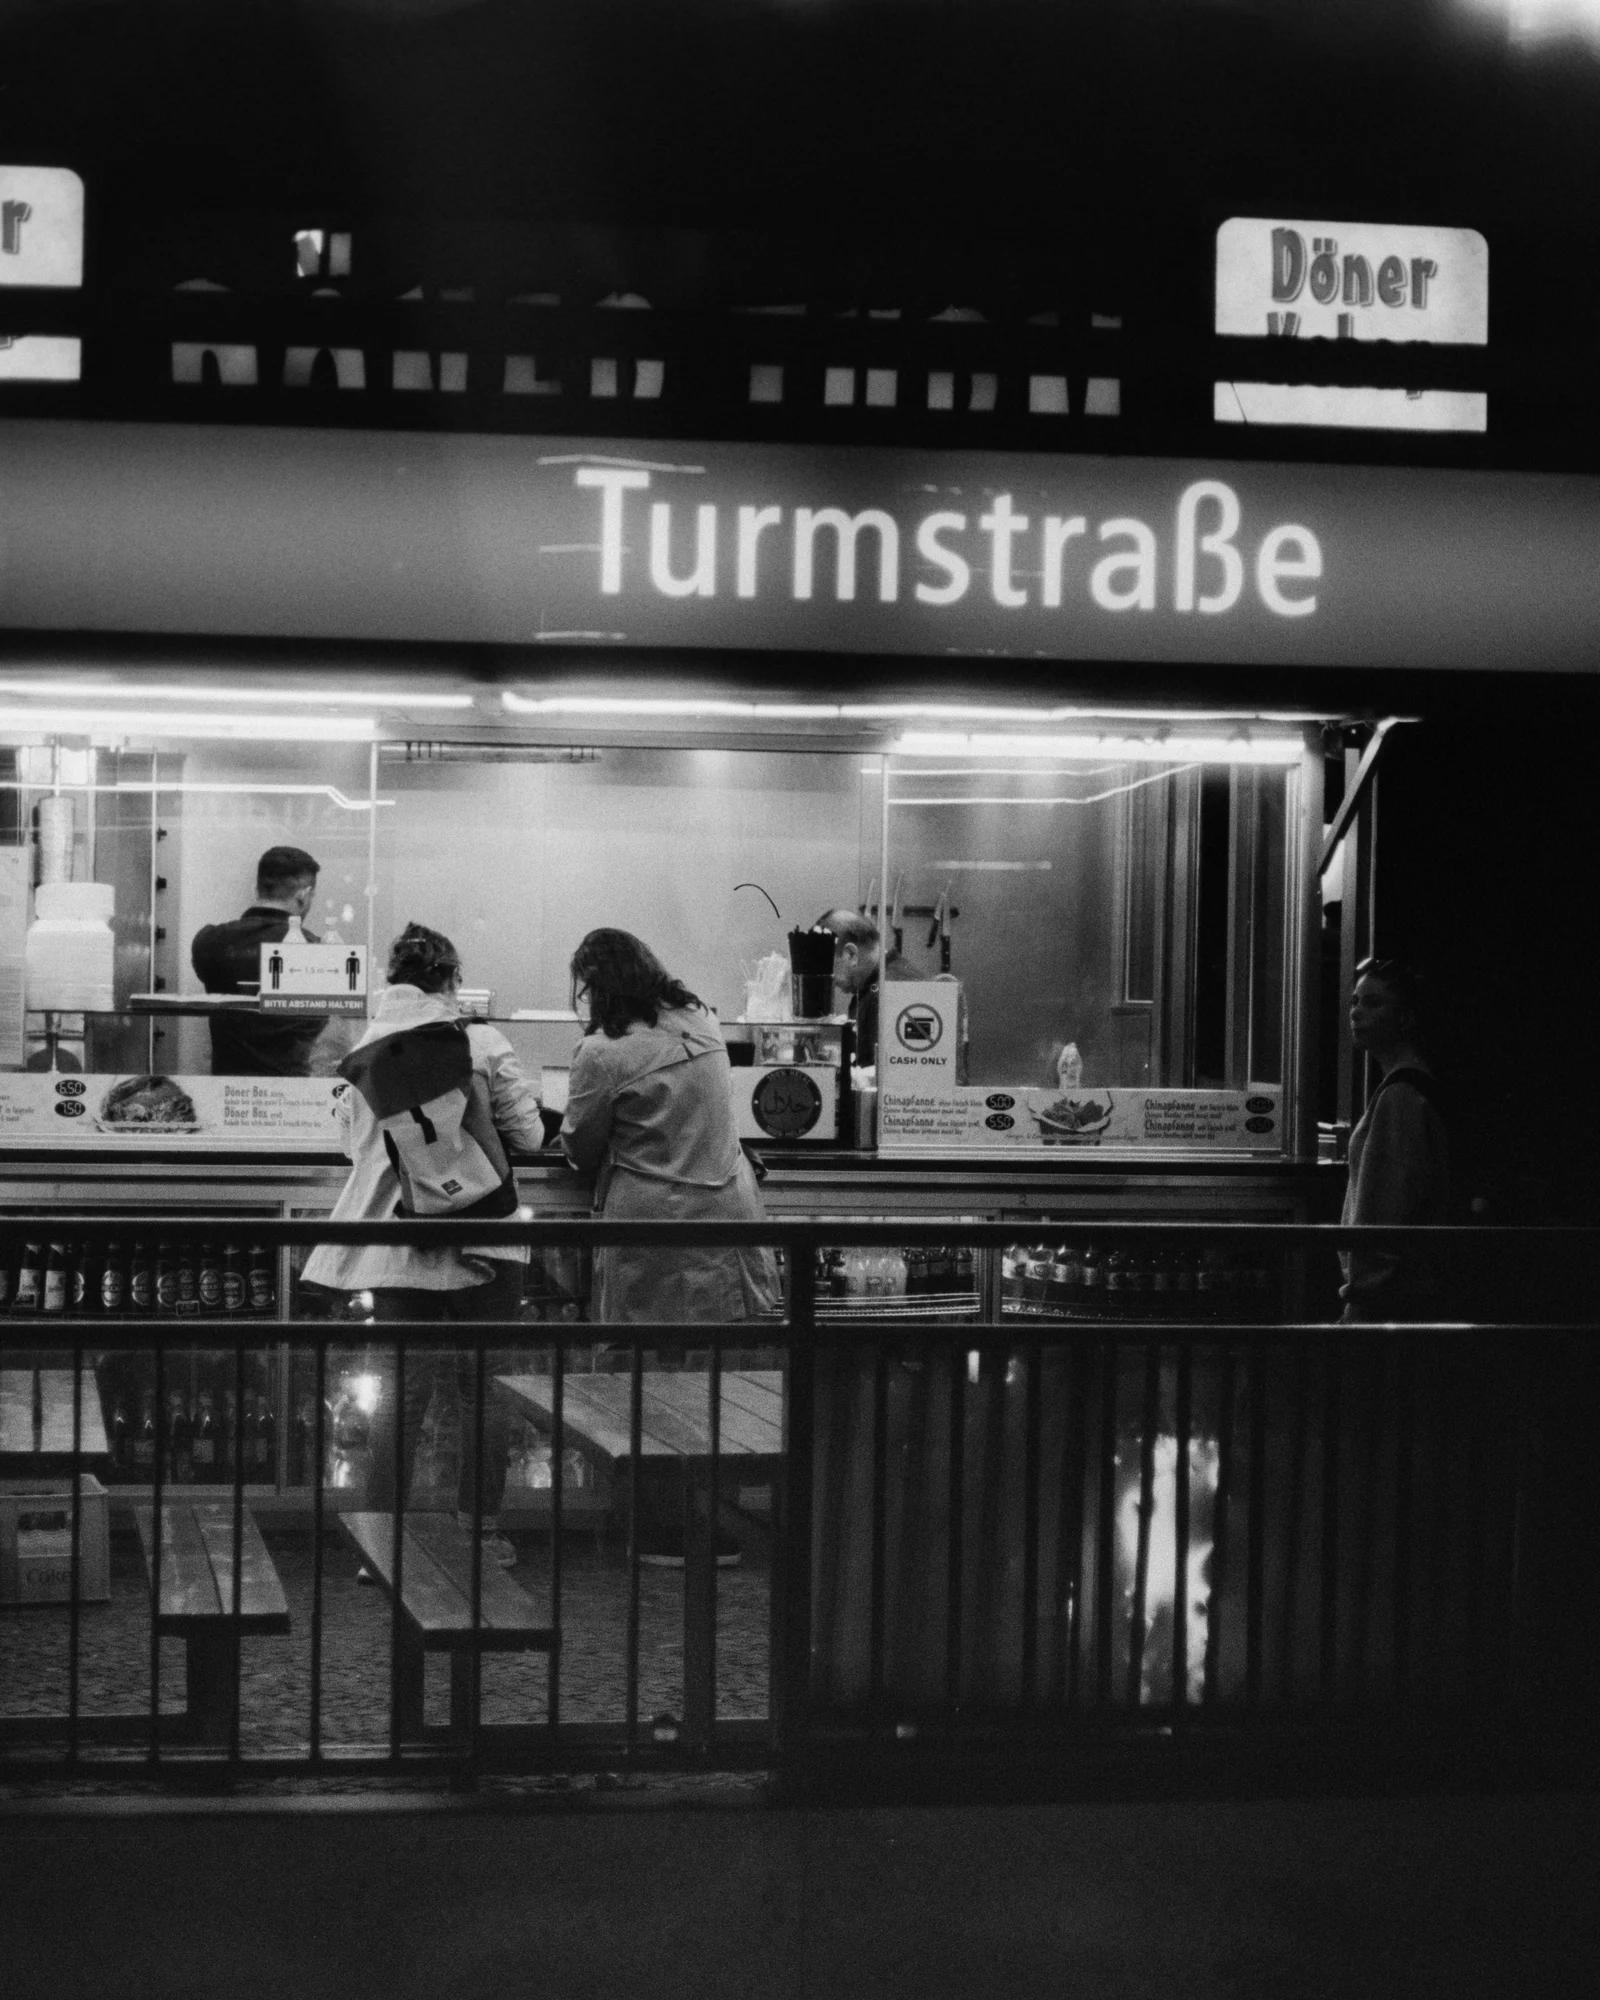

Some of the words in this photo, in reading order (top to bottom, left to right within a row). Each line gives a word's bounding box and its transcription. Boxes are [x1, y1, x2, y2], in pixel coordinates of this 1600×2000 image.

[1271, 227, 1437, 309] Döner
[576, 468, 1323, 616] Turmstraße
[264, 999, 287, 1008] BITTE
[288, 999, 327, 1009] ABSTAND
[328, 1000, 363, 1010] HALTEN!
[889, 1056, 918, 1065] CASH
[920, 1057, 948, 1066] ONLY
